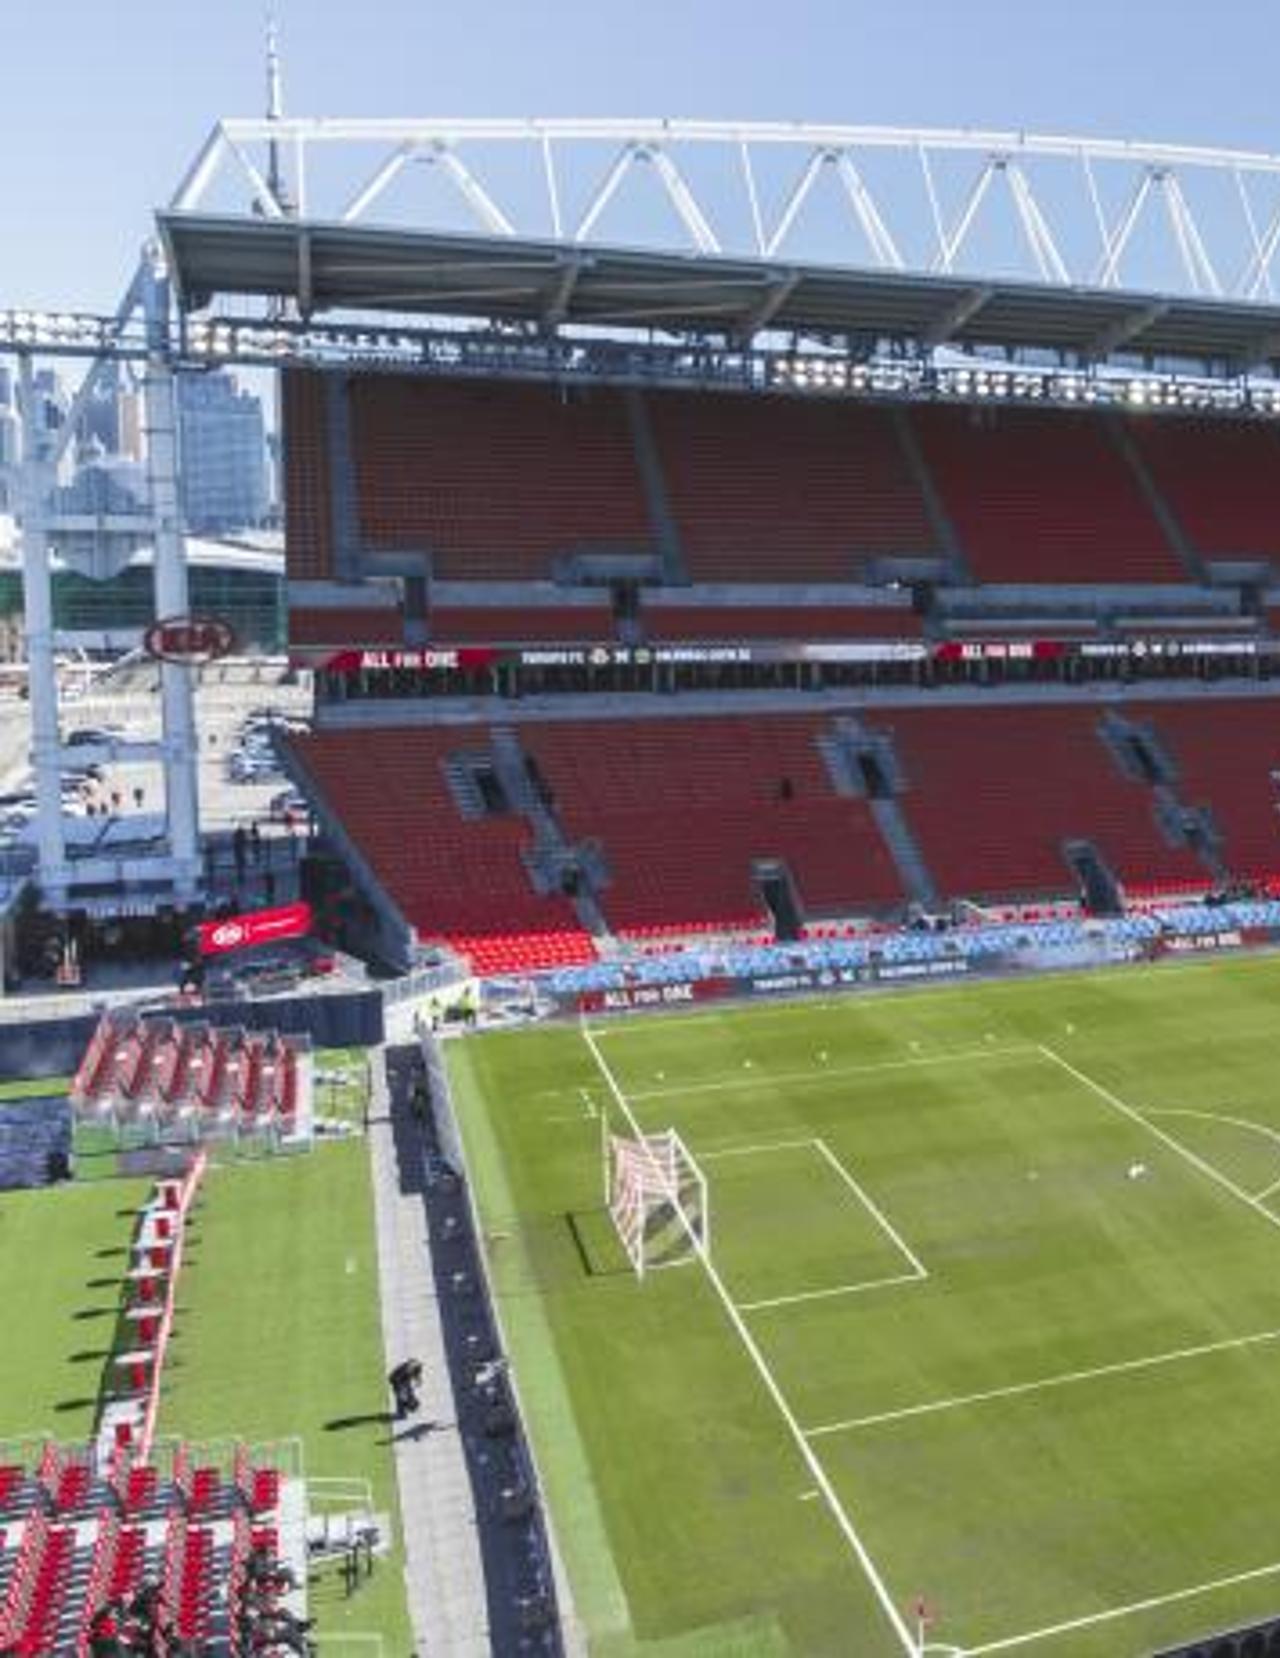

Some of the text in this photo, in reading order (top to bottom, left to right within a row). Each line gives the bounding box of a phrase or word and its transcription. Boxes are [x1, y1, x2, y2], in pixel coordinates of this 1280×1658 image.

[360, 652, 390, 668] ALL
[425, 651, 459, 668] ONE
[604, 991, 632, 1007] ALL
[663, 984, 693, 1002] ONE
